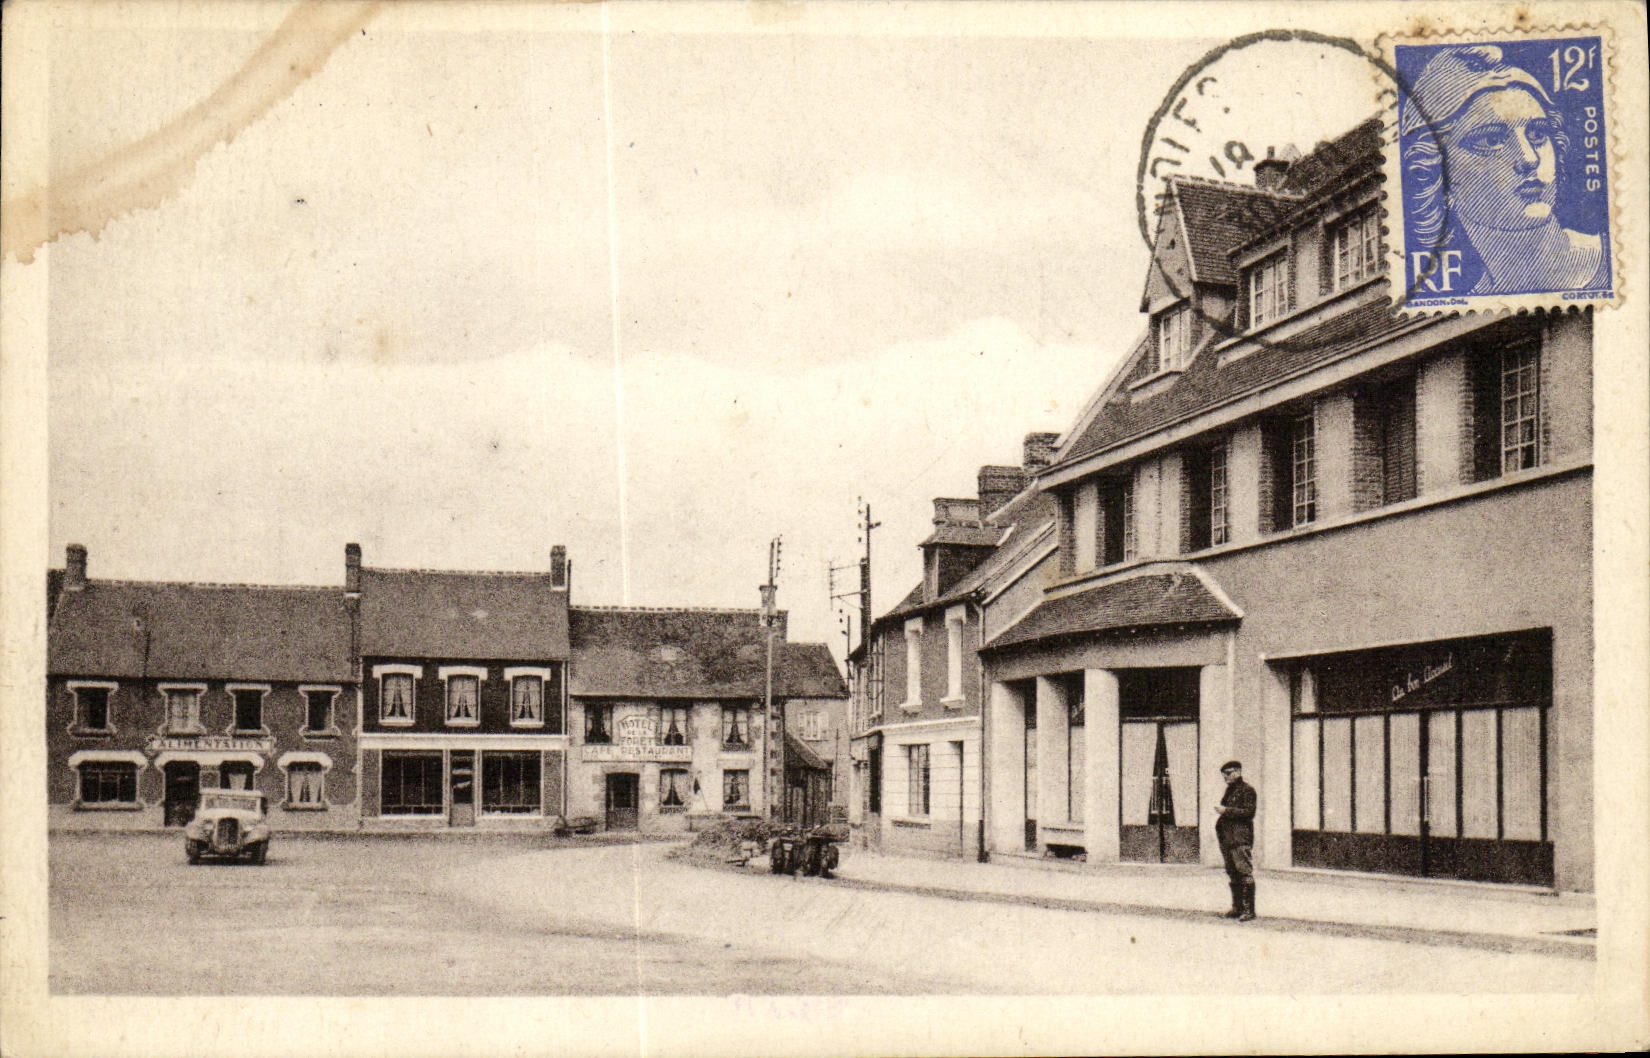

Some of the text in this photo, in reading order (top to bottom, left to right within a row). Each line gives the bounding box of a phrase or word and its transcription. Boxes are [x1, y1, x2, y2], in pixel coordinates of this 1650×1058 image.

[1584, 106, 1601, 192] POSTES
[1410, 249, 1462, 293] RF
[157, 738, 265, 750] ALIMENTATION
